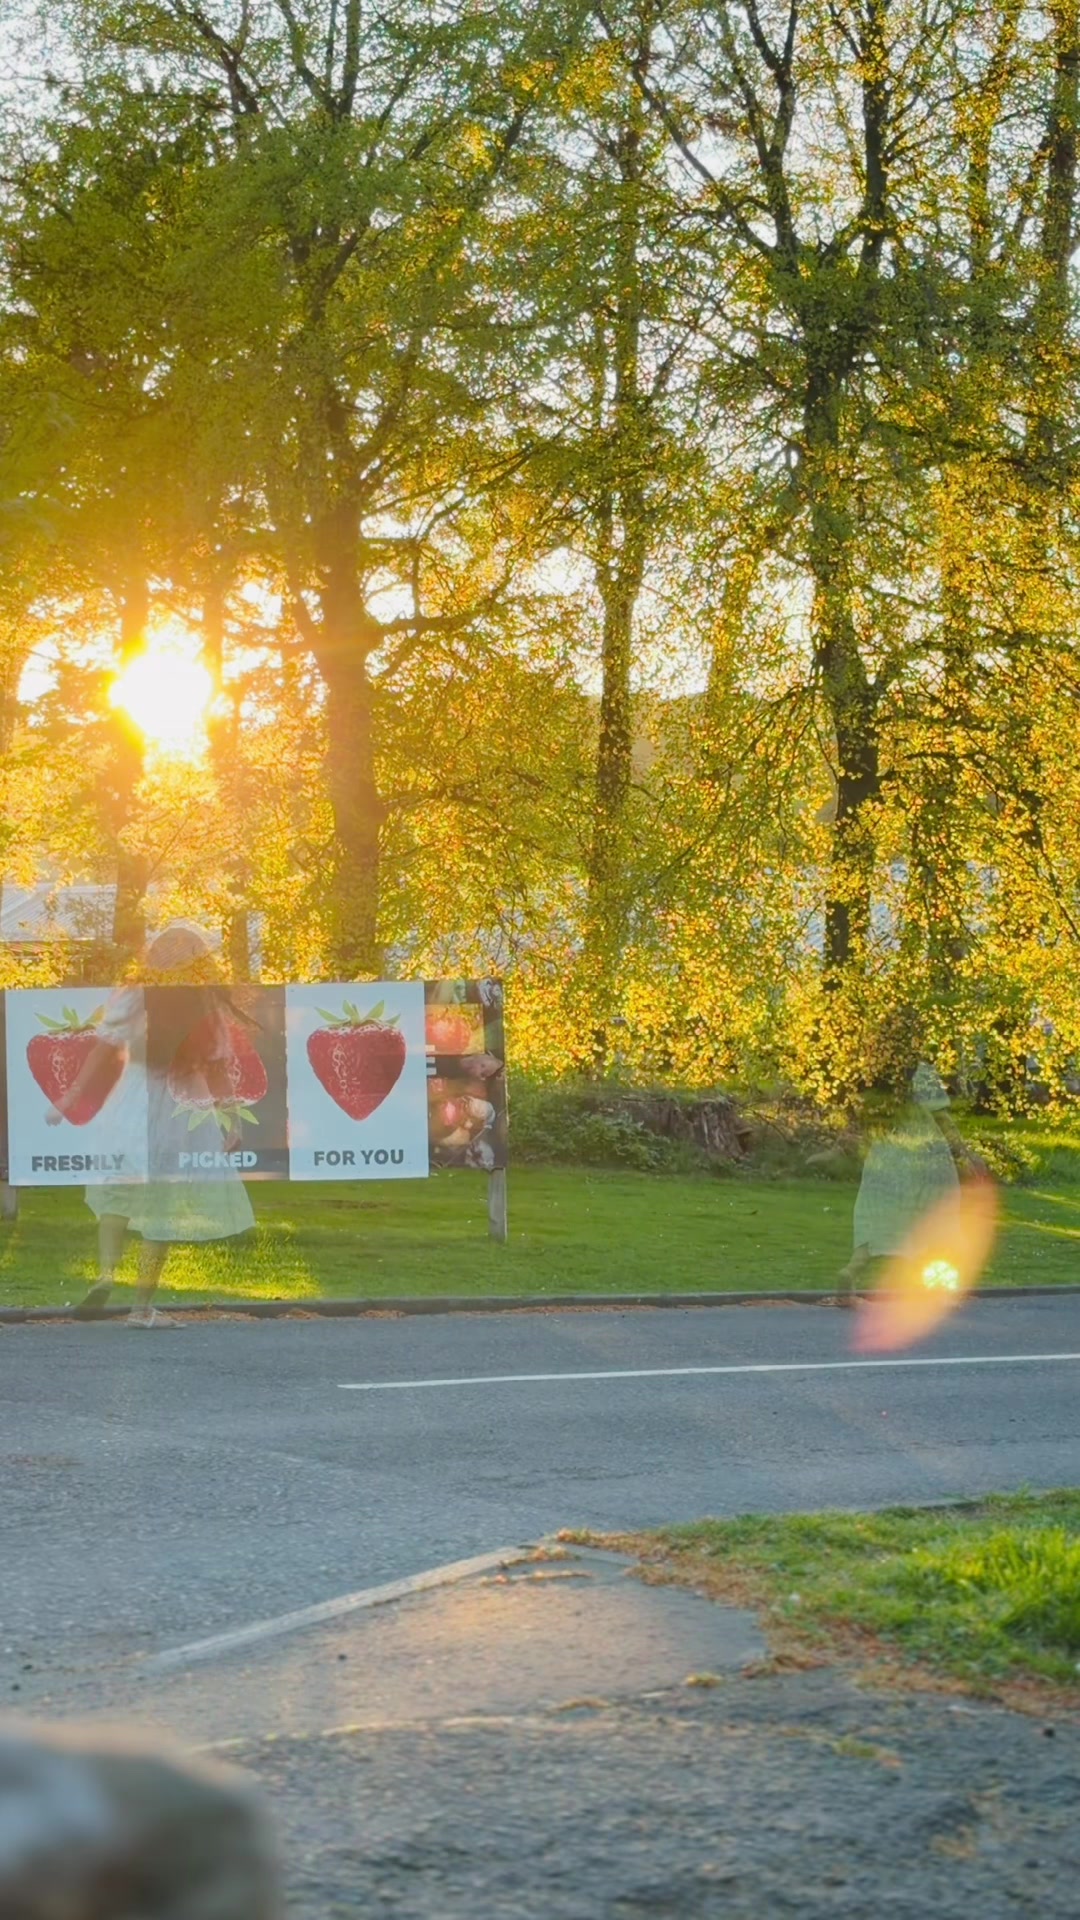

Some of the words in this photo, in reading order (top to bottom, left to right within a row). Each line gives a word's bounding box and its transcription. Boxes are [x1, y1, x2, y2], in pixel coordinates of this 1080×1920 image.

[31, 1154, 125, 1172] FRESHLY
[178, 1151, 258, 1168] PICKED
[313, 1150, 356, 1166] FOR
[360, 1149, 404, 1165] YOU
